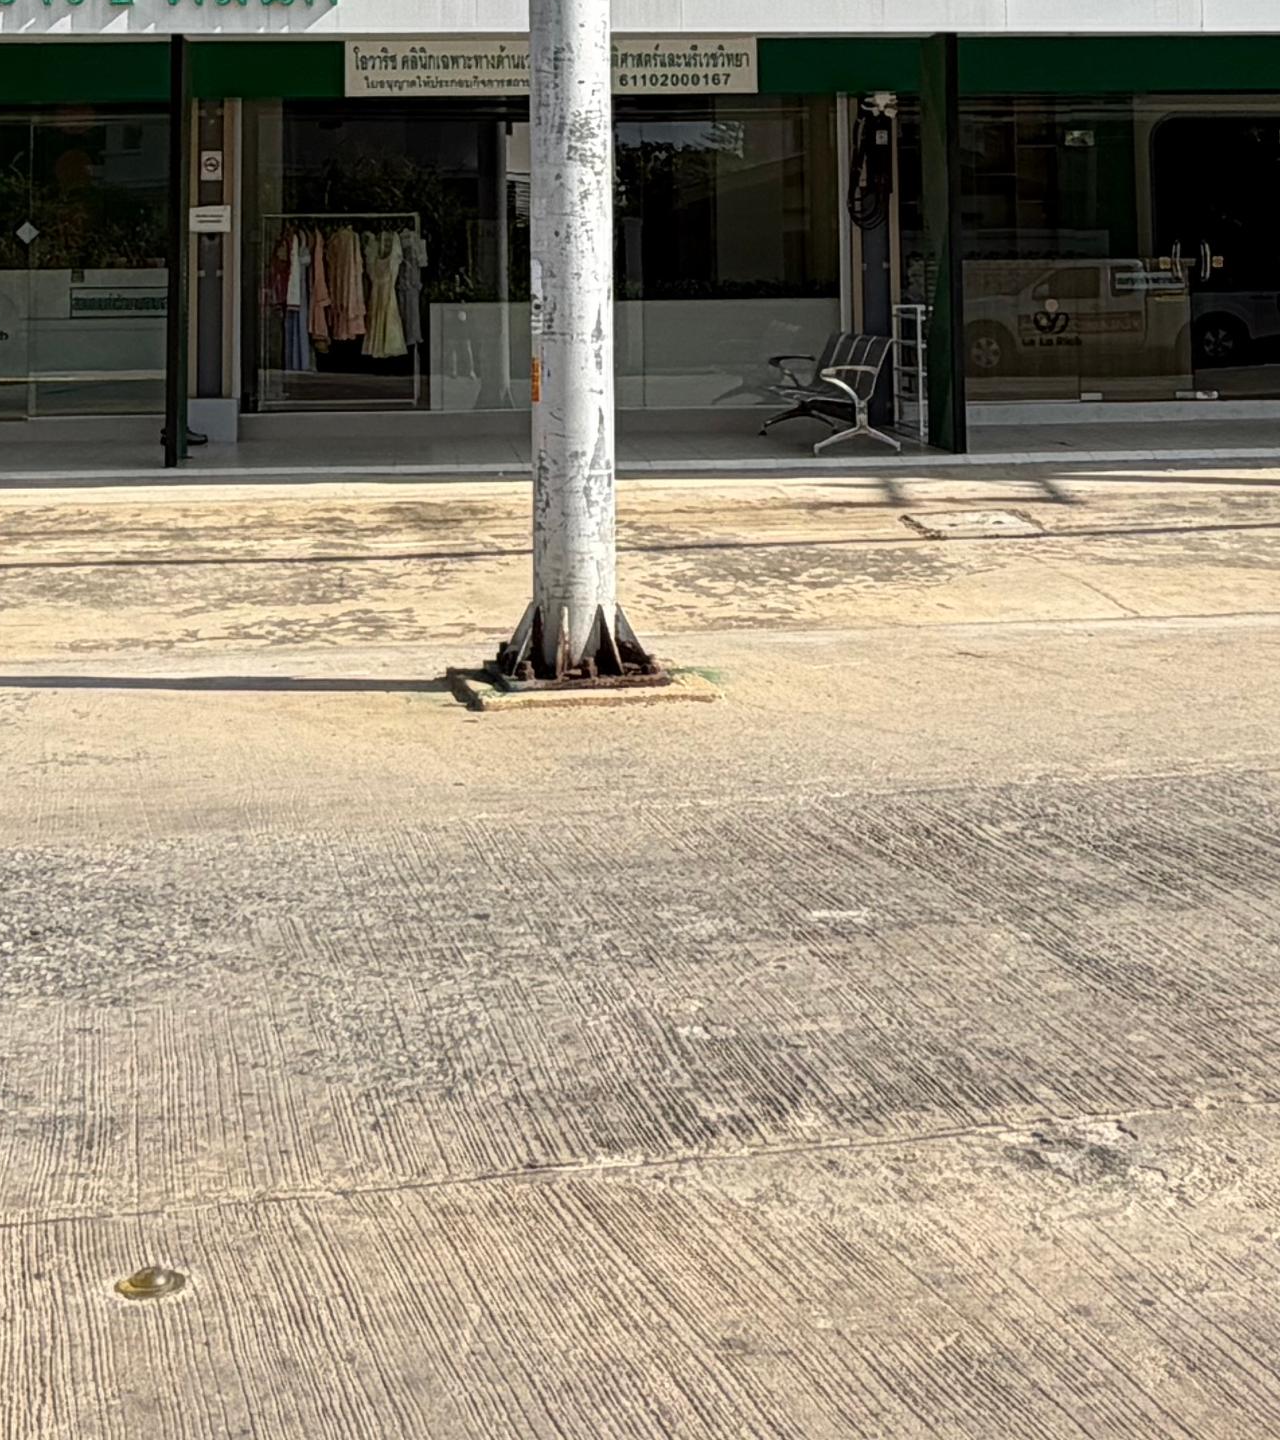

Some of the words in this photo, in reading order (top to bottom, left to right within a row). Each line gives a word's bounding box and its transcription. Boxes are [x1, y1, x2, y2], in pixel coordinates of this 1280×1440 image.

[353, 45, 398, 71] โอวาริช
[618, 72, 732, 88] 61102000167
